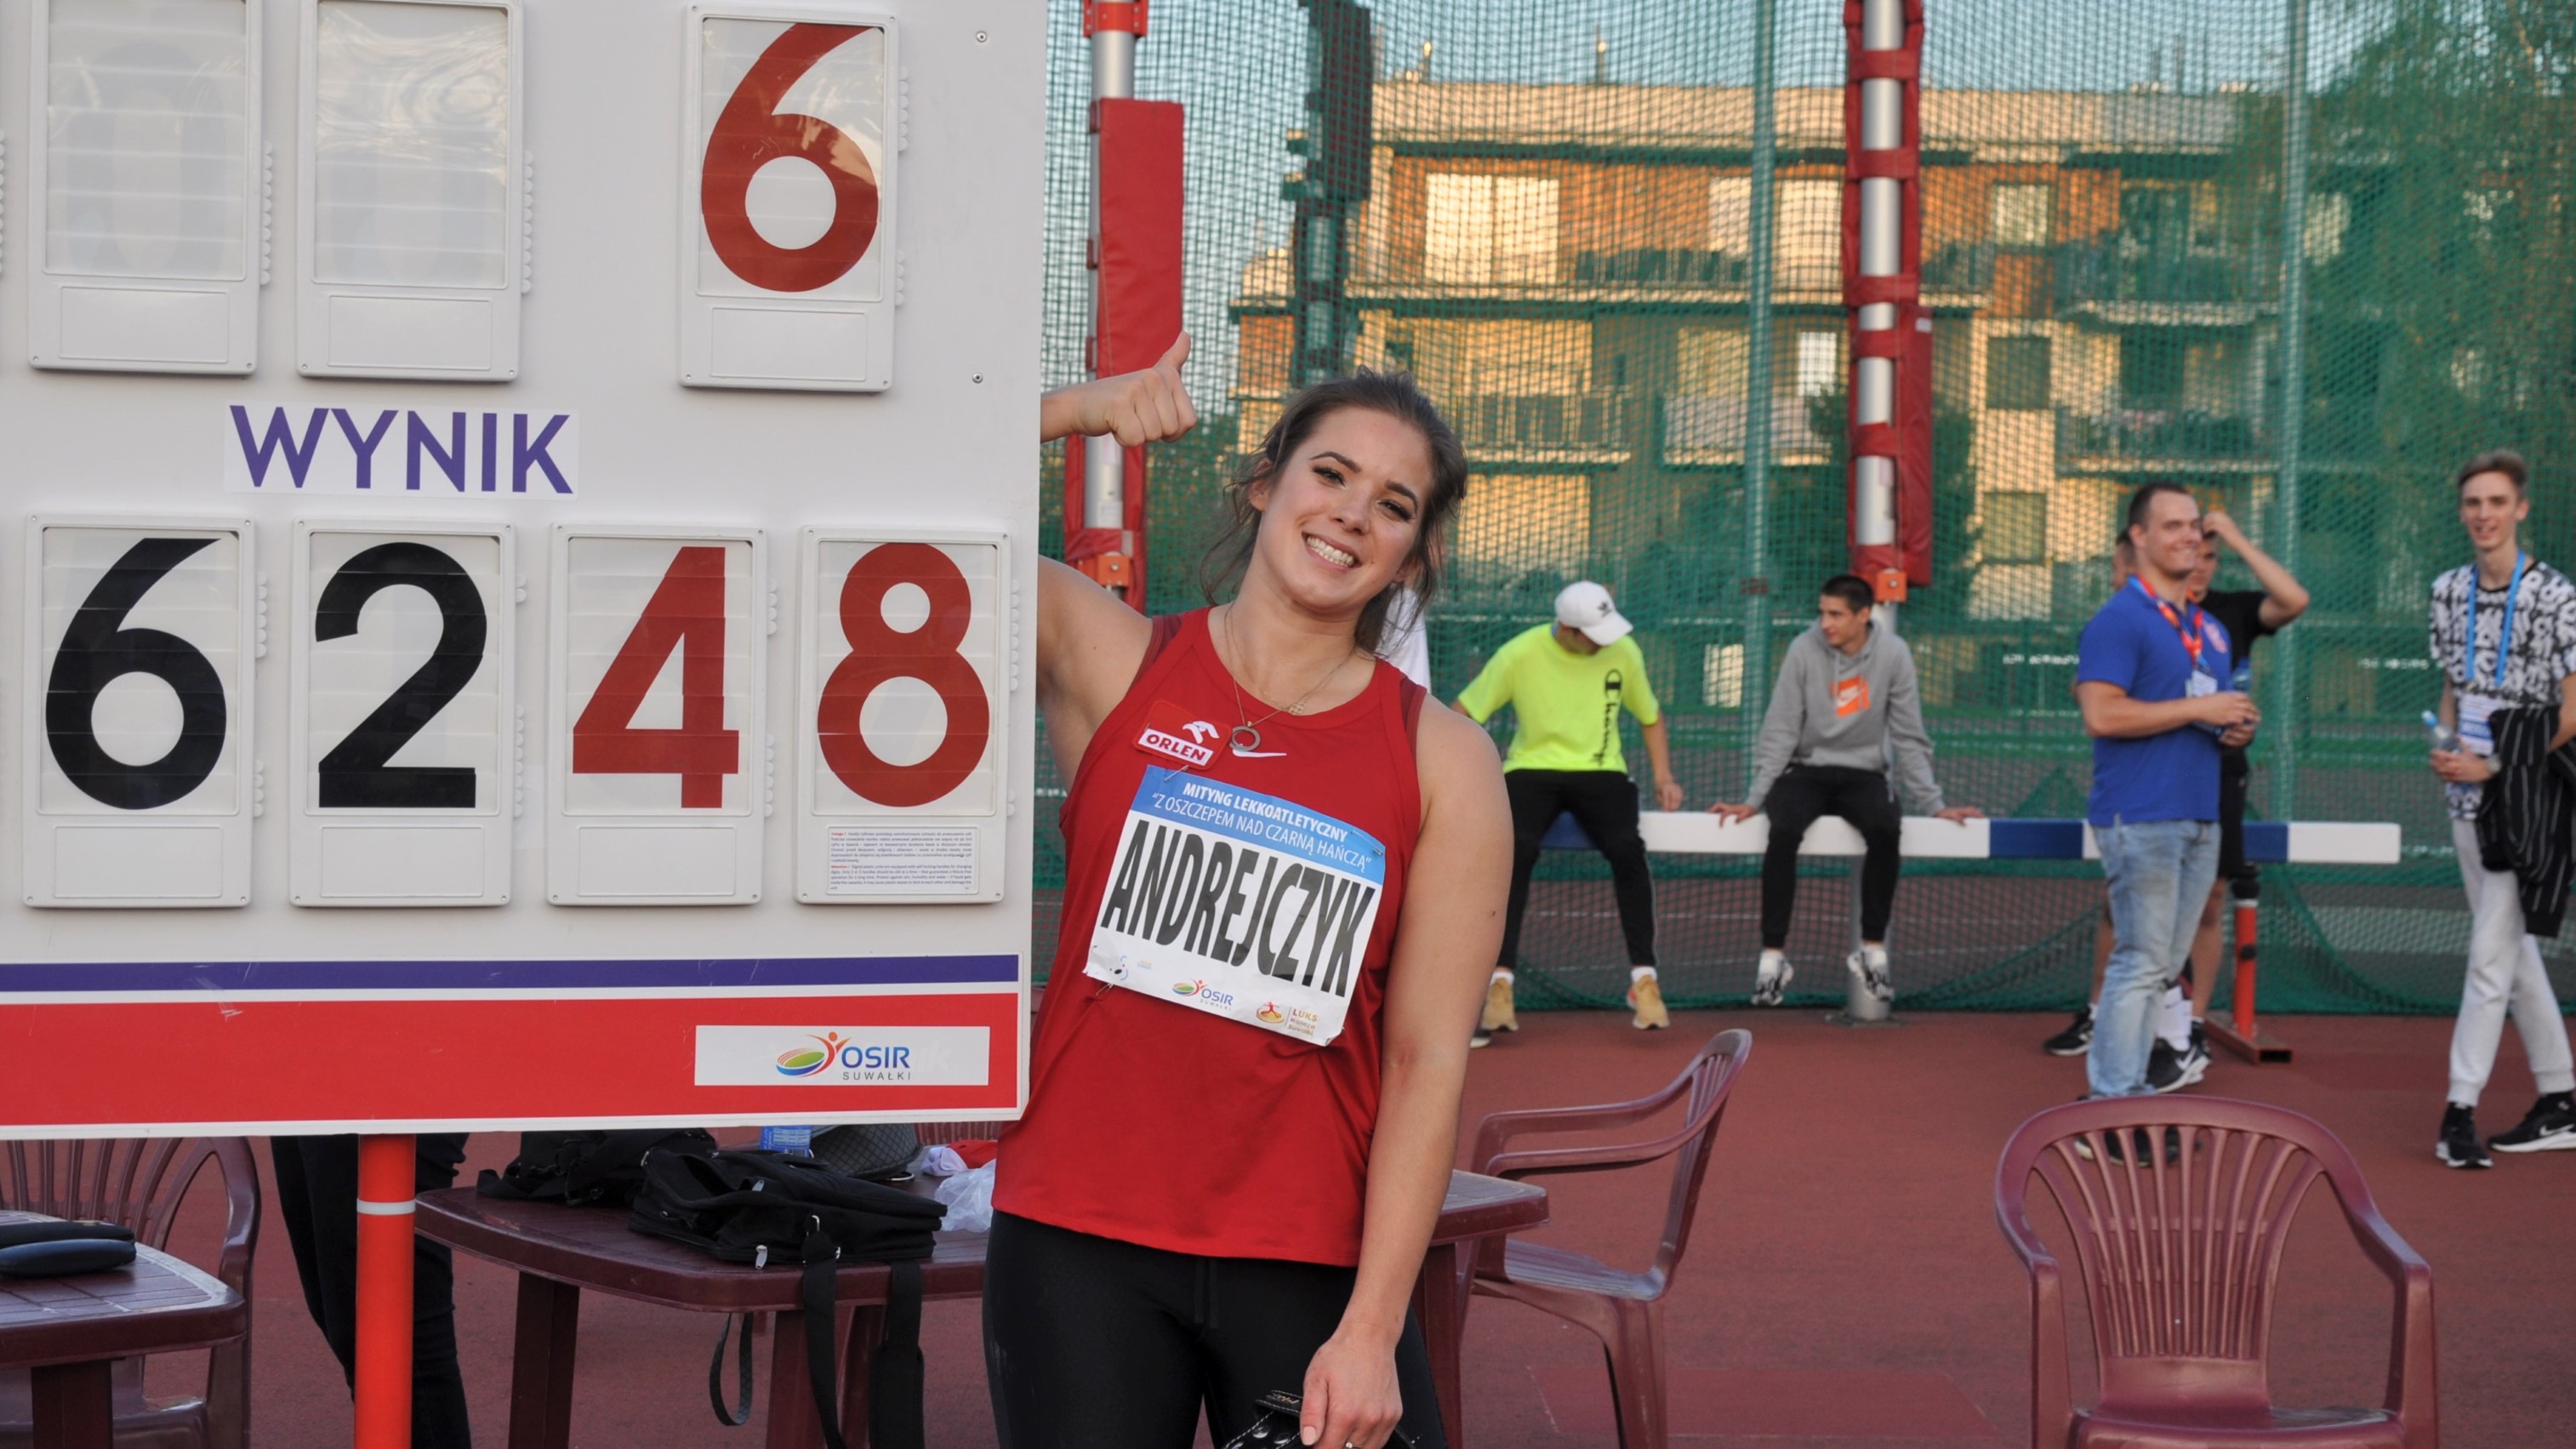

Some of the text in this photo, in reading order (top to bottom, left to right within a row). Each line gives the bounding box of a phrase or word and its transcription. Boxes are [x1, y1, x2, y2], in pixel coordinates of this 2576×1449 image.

[701, 23, 880, 293] 6
[230, 405, 573, 495] WYNIK
[1146, 733, 1206, 761] ORLEN
[1165, 796, 1236, 828] OSZCZEPEM
[1235, 815, 1264, 836] NAD
[1265, 824, 1315, 856] CZARNĄ
[1183, 782, 1348, 842] MITYNG LEKKOATLETYCZNY
[1100, 819, 1376, 998] ANDREJCZYK
[1201, 988, 1234, 1006] OSIR
[1292, 1007, 1319, 1022] LUKS
[841, 1046, 911, 1070] OSIR
[842, 1071, 911, 1081] SUWAŁKI
